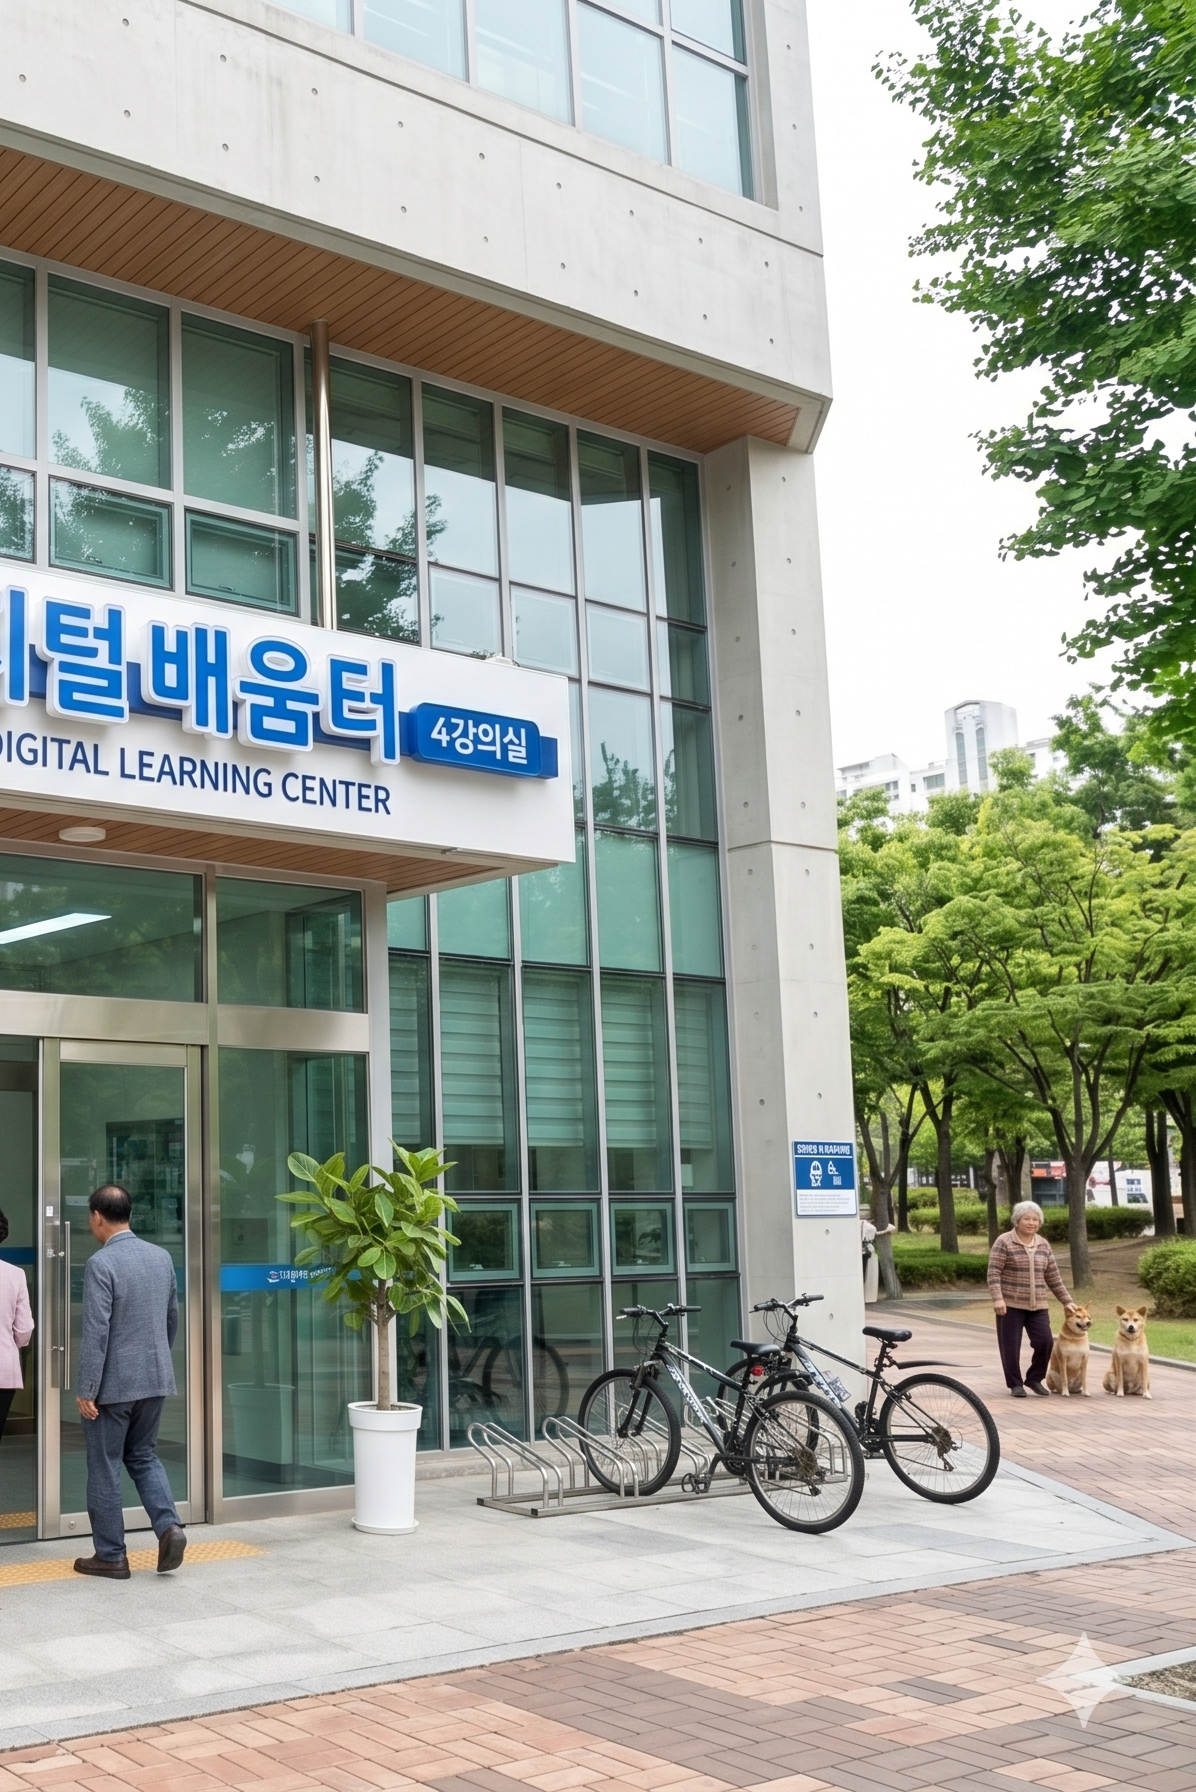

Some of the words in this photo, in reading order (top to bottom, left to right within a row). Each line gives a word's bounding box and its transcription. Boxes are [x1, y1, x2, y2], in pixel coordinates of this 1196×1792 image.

[430, 715, 528, 765] 4강의실
[119, 747, 273, 799] LEARNING
[281, 771, 392, 816] CENTER
